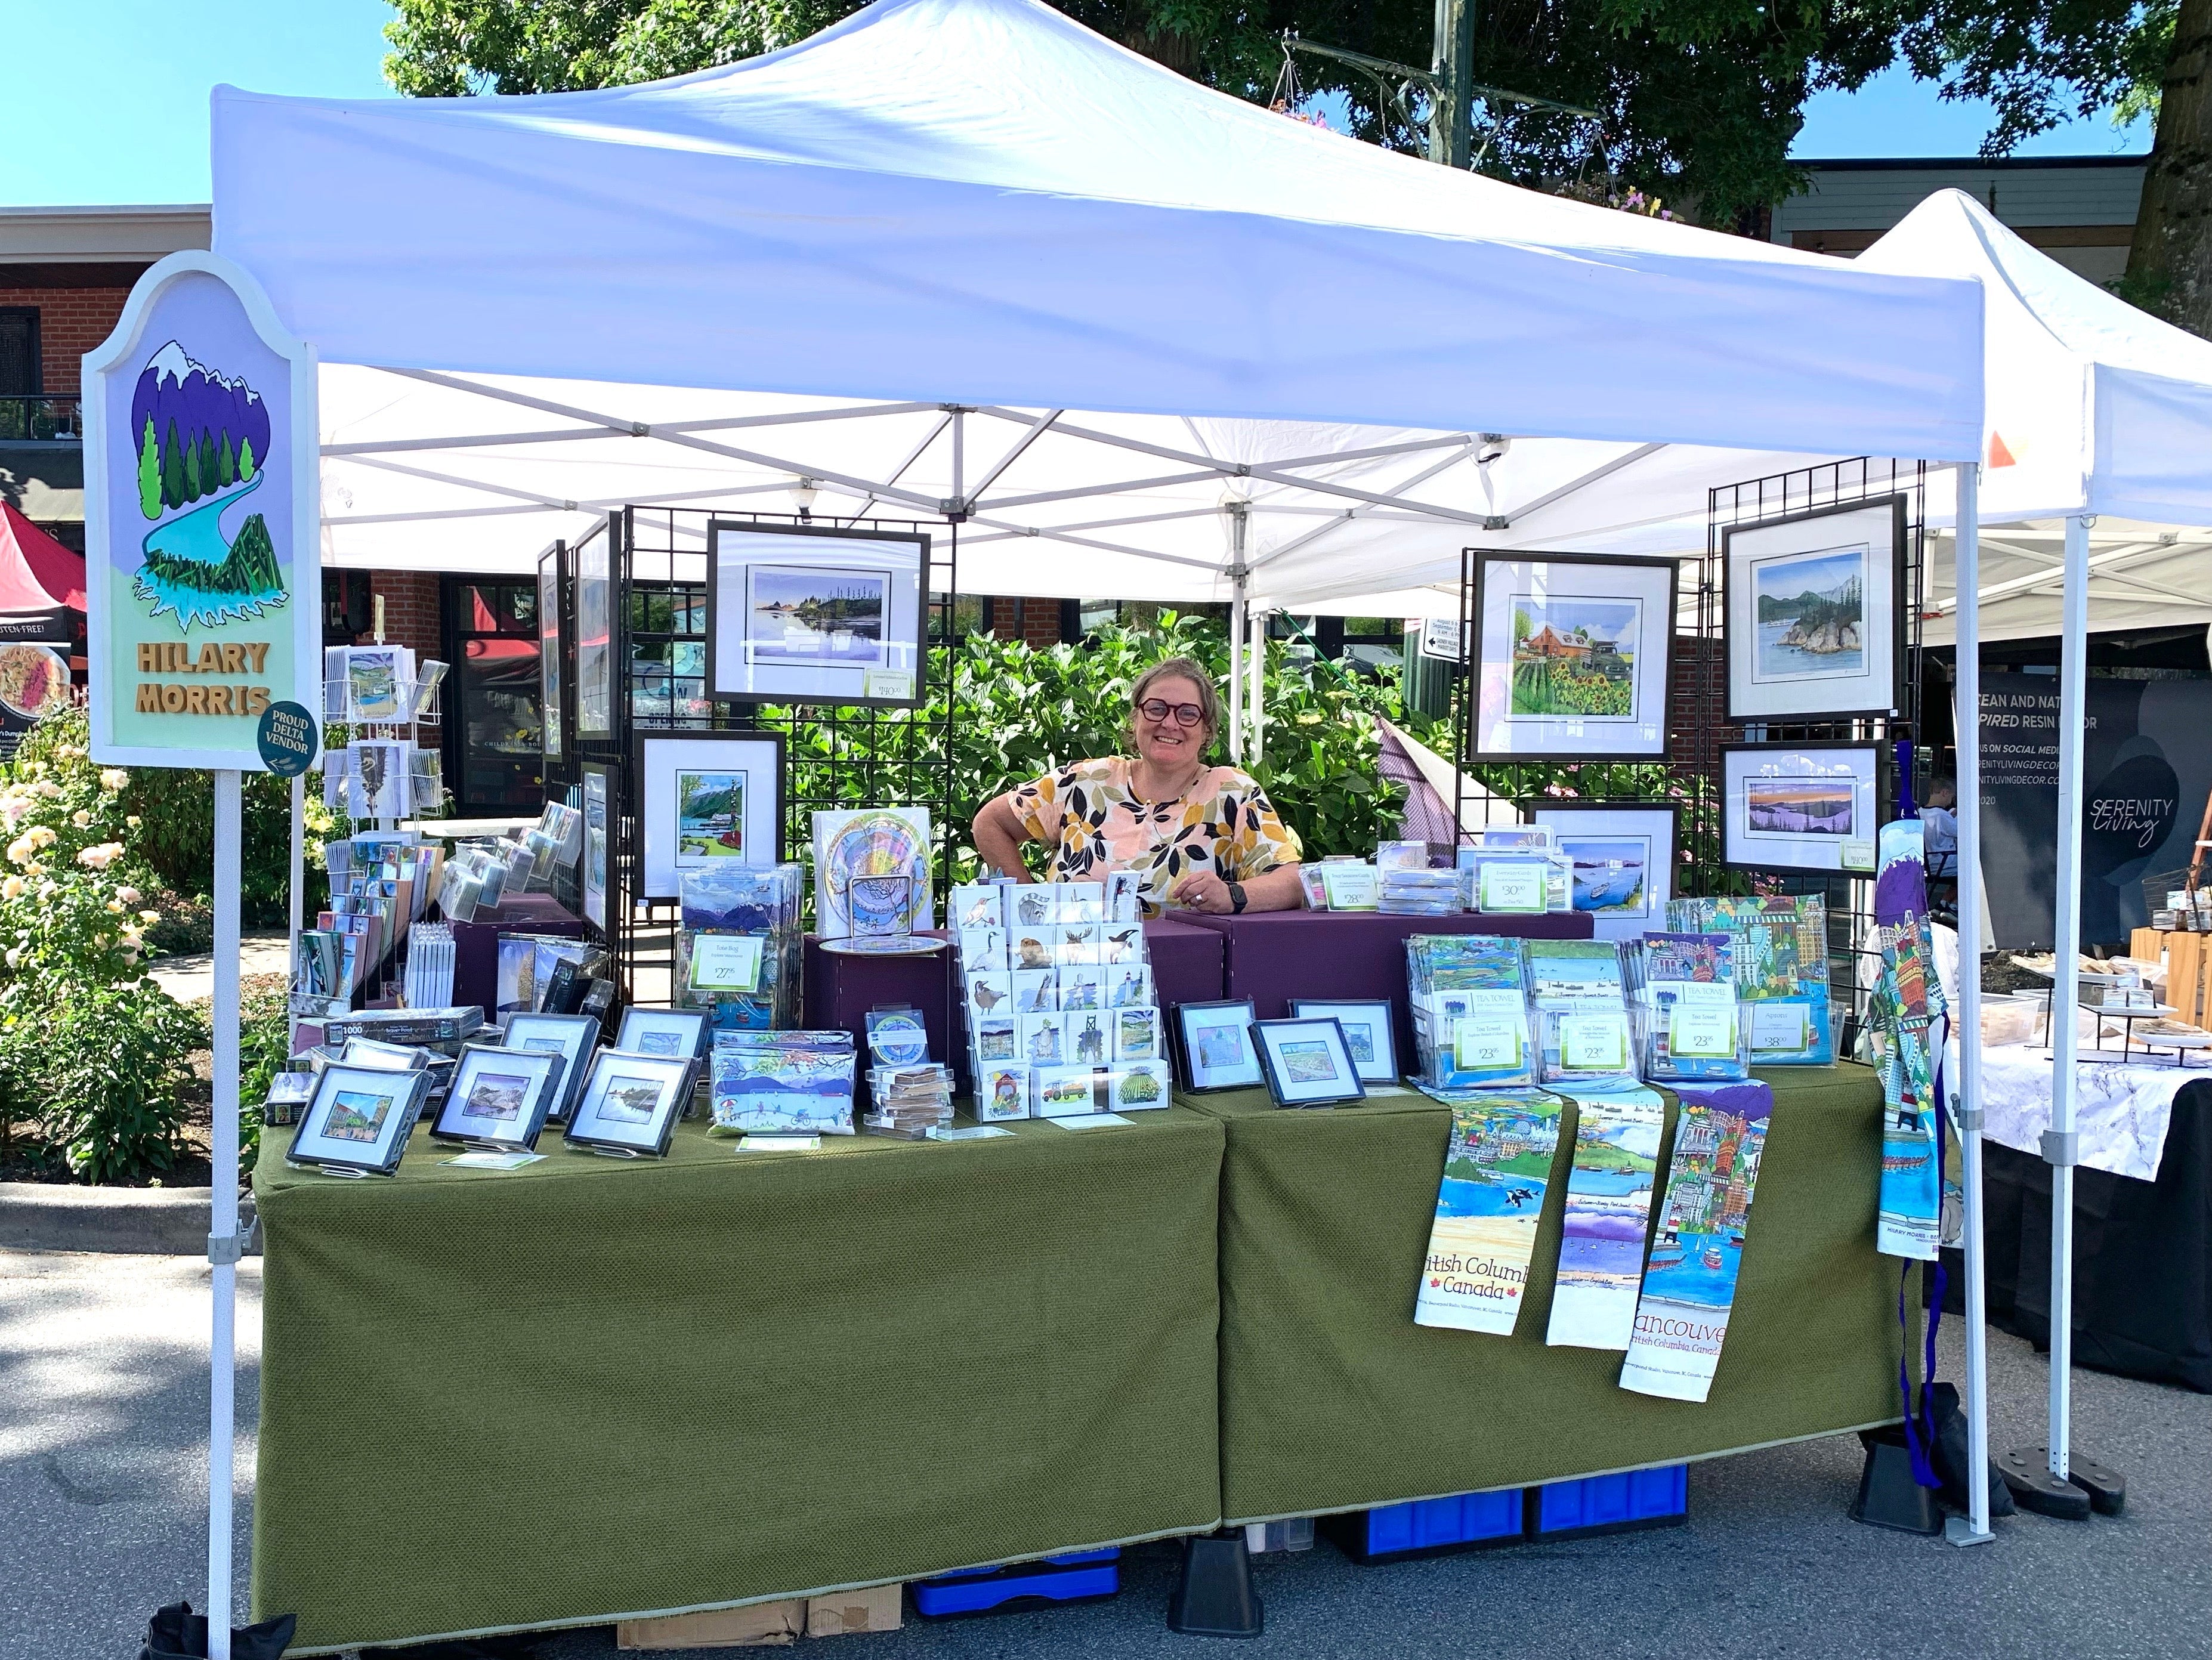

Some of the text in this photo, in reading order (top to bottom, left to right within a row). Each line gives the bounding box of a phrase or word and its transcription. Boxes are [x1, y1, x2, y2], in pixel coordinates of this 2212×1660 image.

[137, 642, 270, 673] HILARY
[135, 683, 272, 716] MORRIS
[1978, 693, 2007, 707] EAN
[2010, 694, 2035, 708] AND
[272, 709, 309, 730] PROUD
[648, 712, 687, 724] OPENNG
[2022, 715, 2056, 728] RESIN
[272, 722, 304, 741] DELTA
[265, 731, 309, 755] VENDOR
[1980, 744, 1988, 753] US
[1989, 744, 2001, 753] ON
[2002, 744, 2037, 755] SOCIAL
[1979, 796, 1996, 805] 020
[2090, 799, 2173, 817] SERENITY
[343, 1025, 363, 1035] 1000
[1887, 1227, 1906, 1235] HILARY
[1443, 1276, 1504, 1300] Canada
[1654, 1338, 1691, 1352] Columbia,
